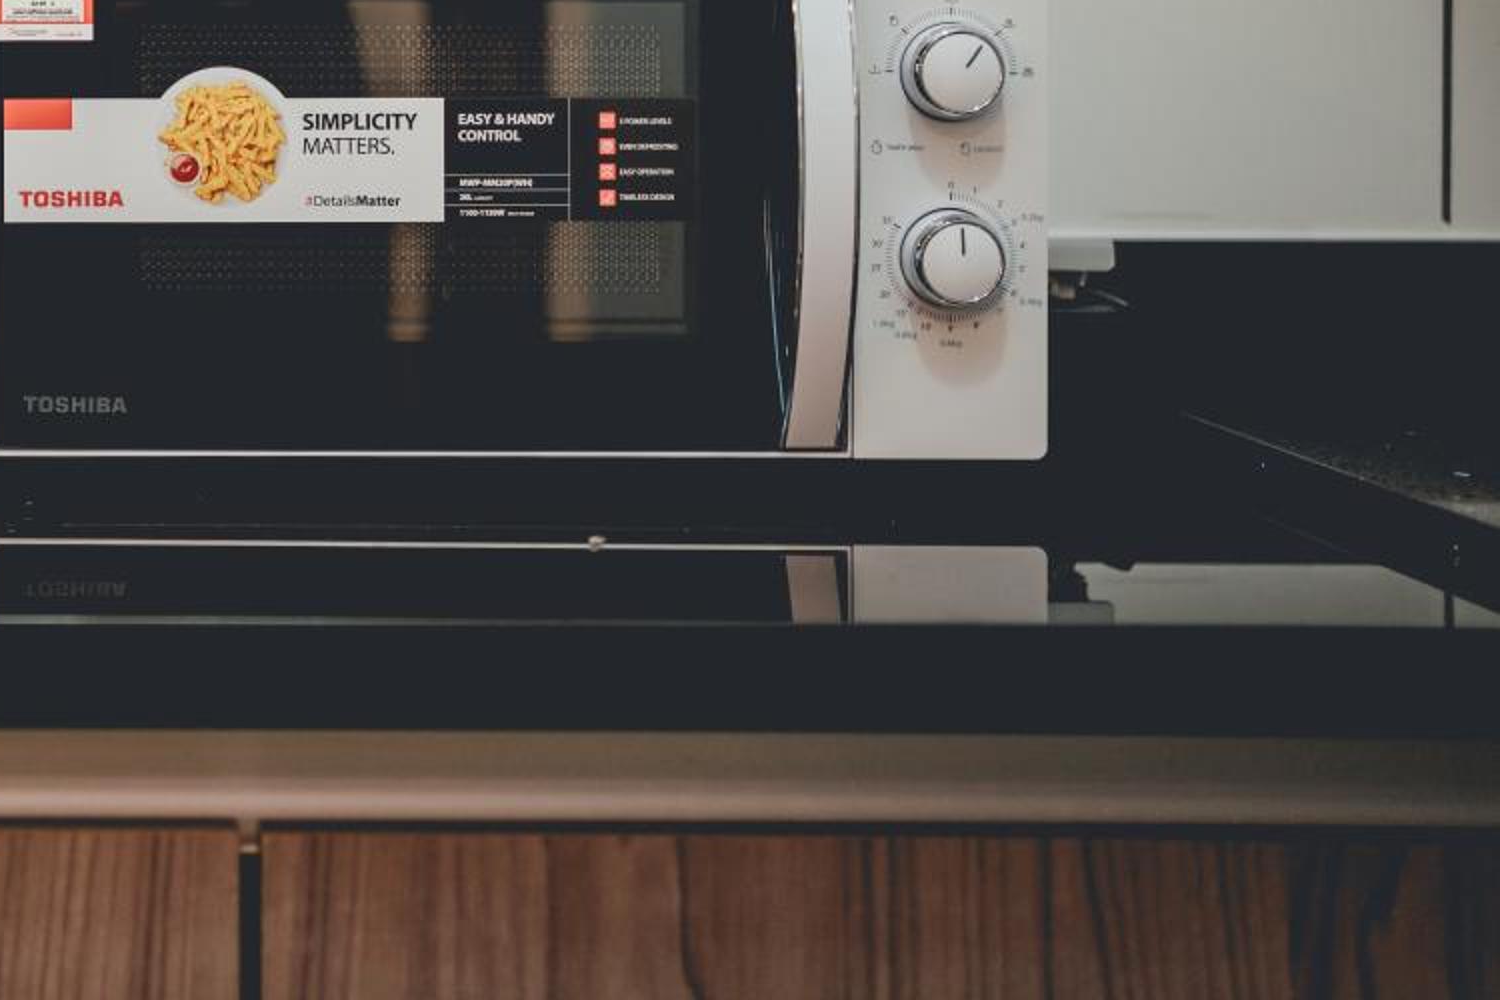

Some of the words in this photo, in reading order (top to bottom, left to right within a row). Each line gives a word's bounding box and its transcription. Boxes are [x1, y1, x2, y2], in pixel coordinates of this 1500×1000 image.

[302, 113, 418, 131] SIMPLICITY
[457, 112, 493, 125] EASY
[494, 113, 505, 125] &
[506, 112, 555, 125] HANDY
[457, 129, 522, 143] CONTROL
[302, 137, 395, 155] MATTERS.
[19, 190, 124, 208] TOSHIBA
[306, 194, 401, 207] #DetailsMatter
[22, 394, 128, 414] TOSHIBA
